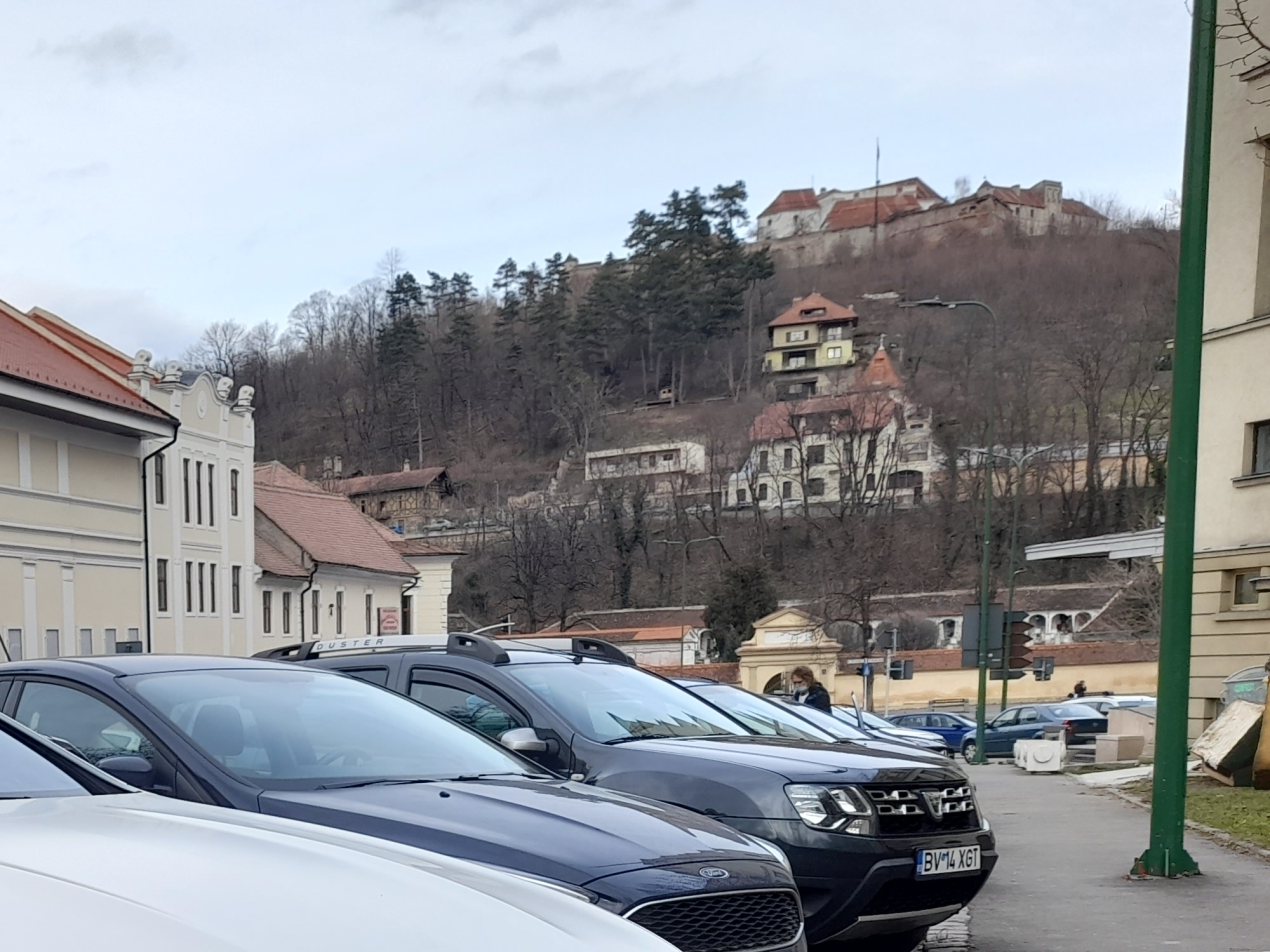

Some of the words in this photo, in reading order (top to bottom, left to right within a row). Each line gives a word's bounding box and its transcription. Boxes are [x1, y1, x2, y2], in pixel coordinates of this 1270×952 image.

[316, 638, 384, 651] DUSTER
[924, 851, 942, 872] BV
[944, 849, 956, 870] 14
[958, 847, 978, 869] XGT
